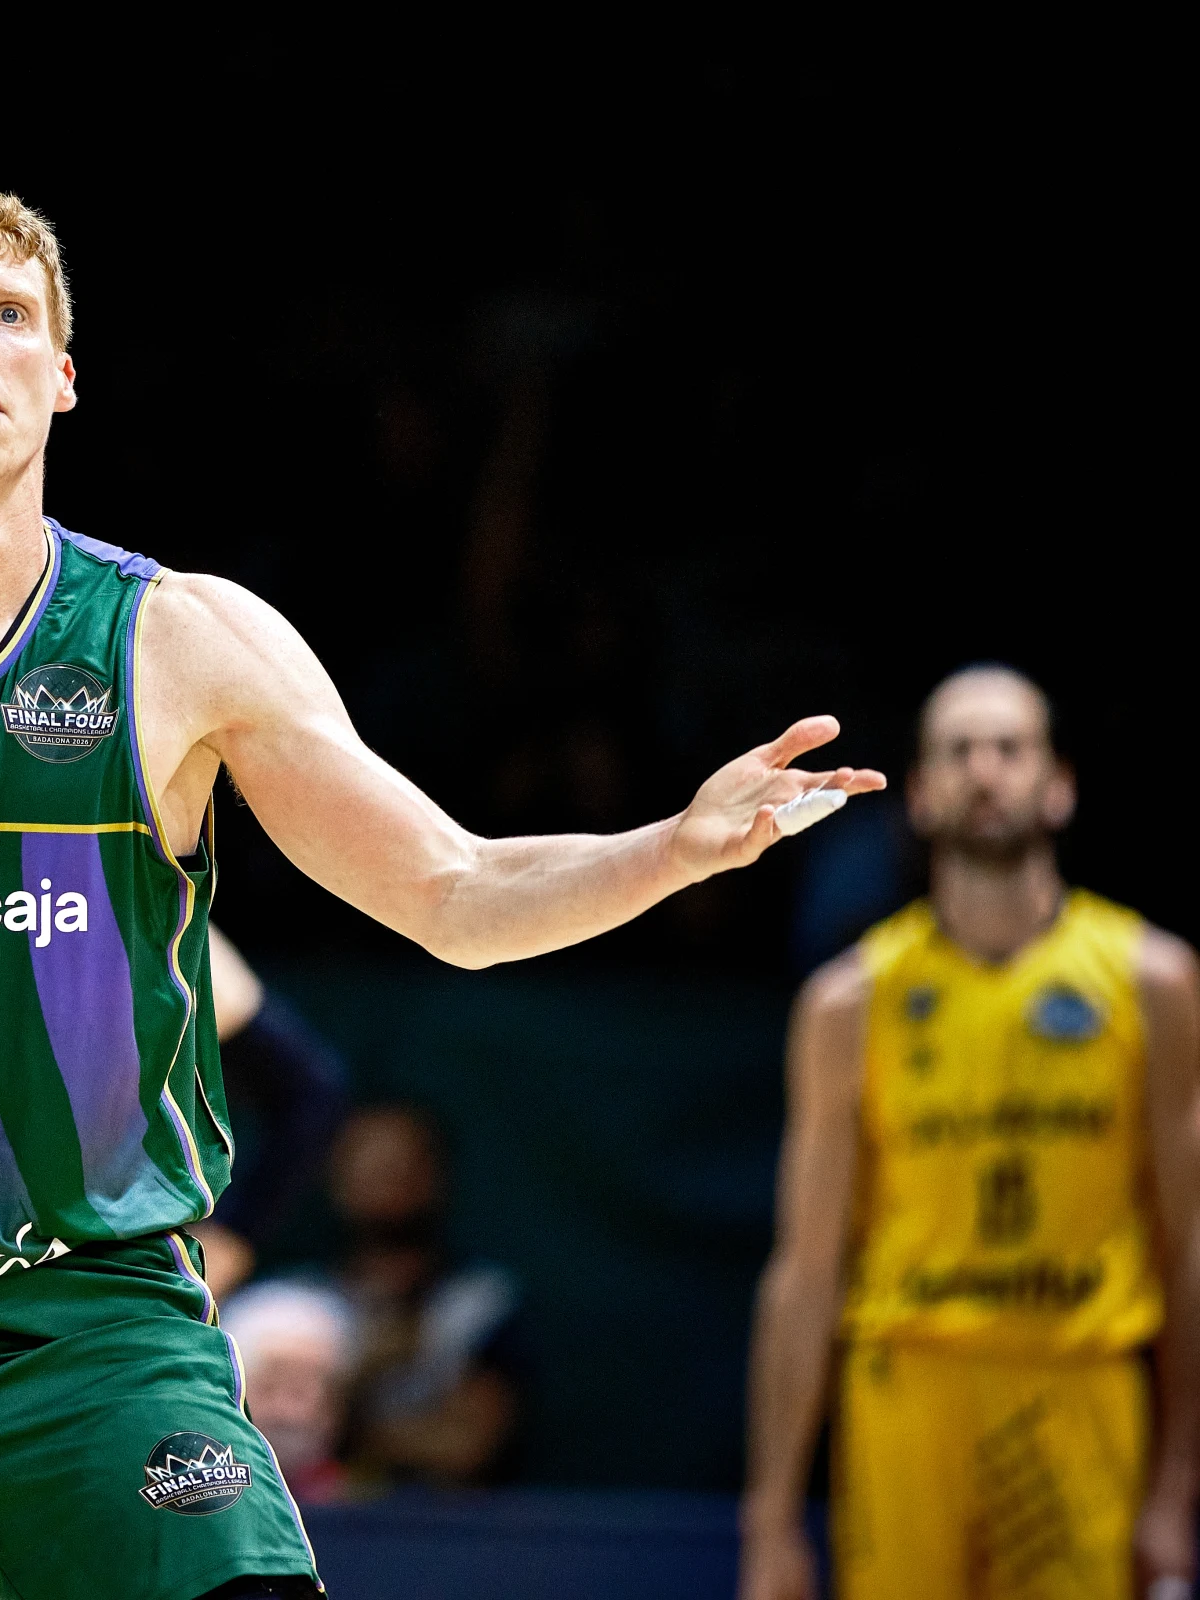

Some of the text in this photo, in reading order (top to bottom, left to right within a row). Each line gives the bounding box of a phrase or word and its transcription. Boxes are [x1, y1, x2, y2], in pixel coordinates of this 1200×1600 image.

[7, 708, 114, 729] FINAL FOUR
[10, 724, 48, 733] BASKETBALL
[49, 727, 86, 735] CHAMPIONS
[32, 736, 71, 744] BADALONA
[145, 1467, 247, 1500] FINAL FOUR
[181, 1490, 218, 1504] BADALONA
